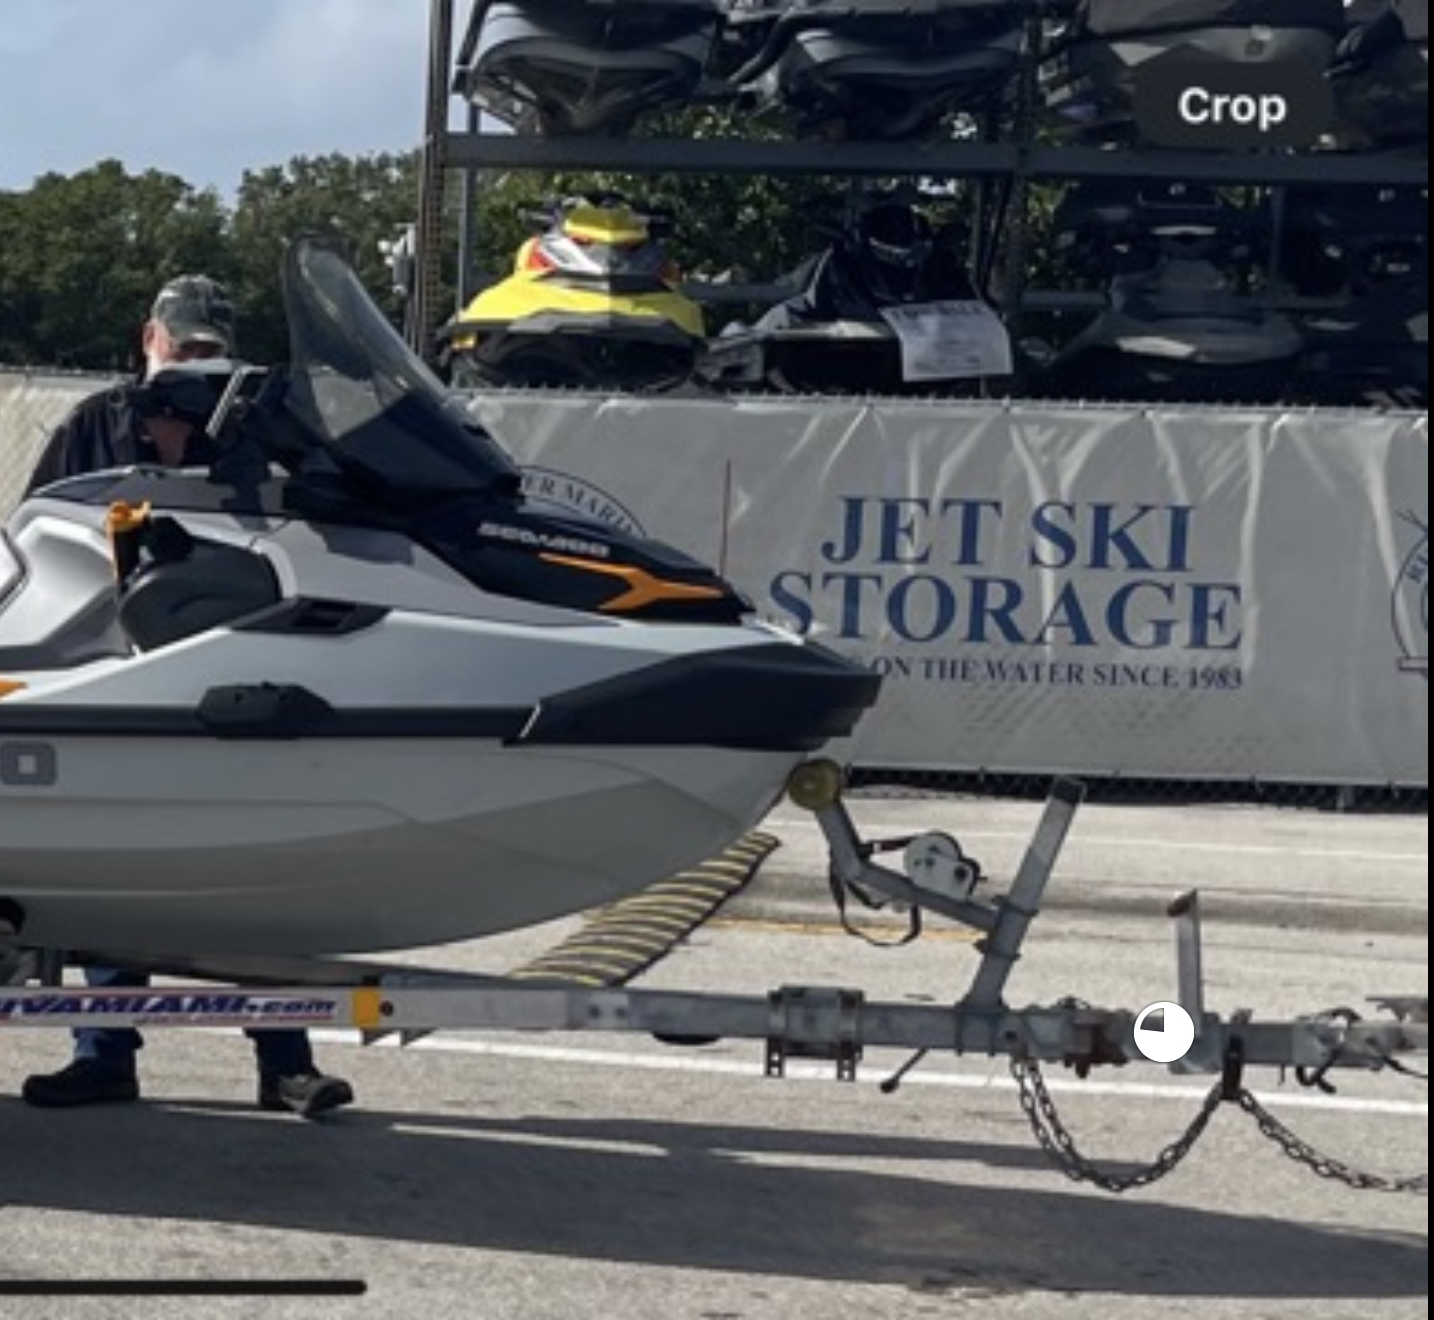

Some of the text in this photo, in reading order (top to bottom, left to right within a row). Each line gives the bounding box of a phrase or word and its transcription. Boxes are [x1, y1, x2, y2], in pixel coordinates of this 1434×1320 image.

[821, 498, 1195, 572] JET SKI
[769, 570, 1243, 651] STORAGE
[868, 656, 1243, 689] ON THE WATER SINCE 1983
